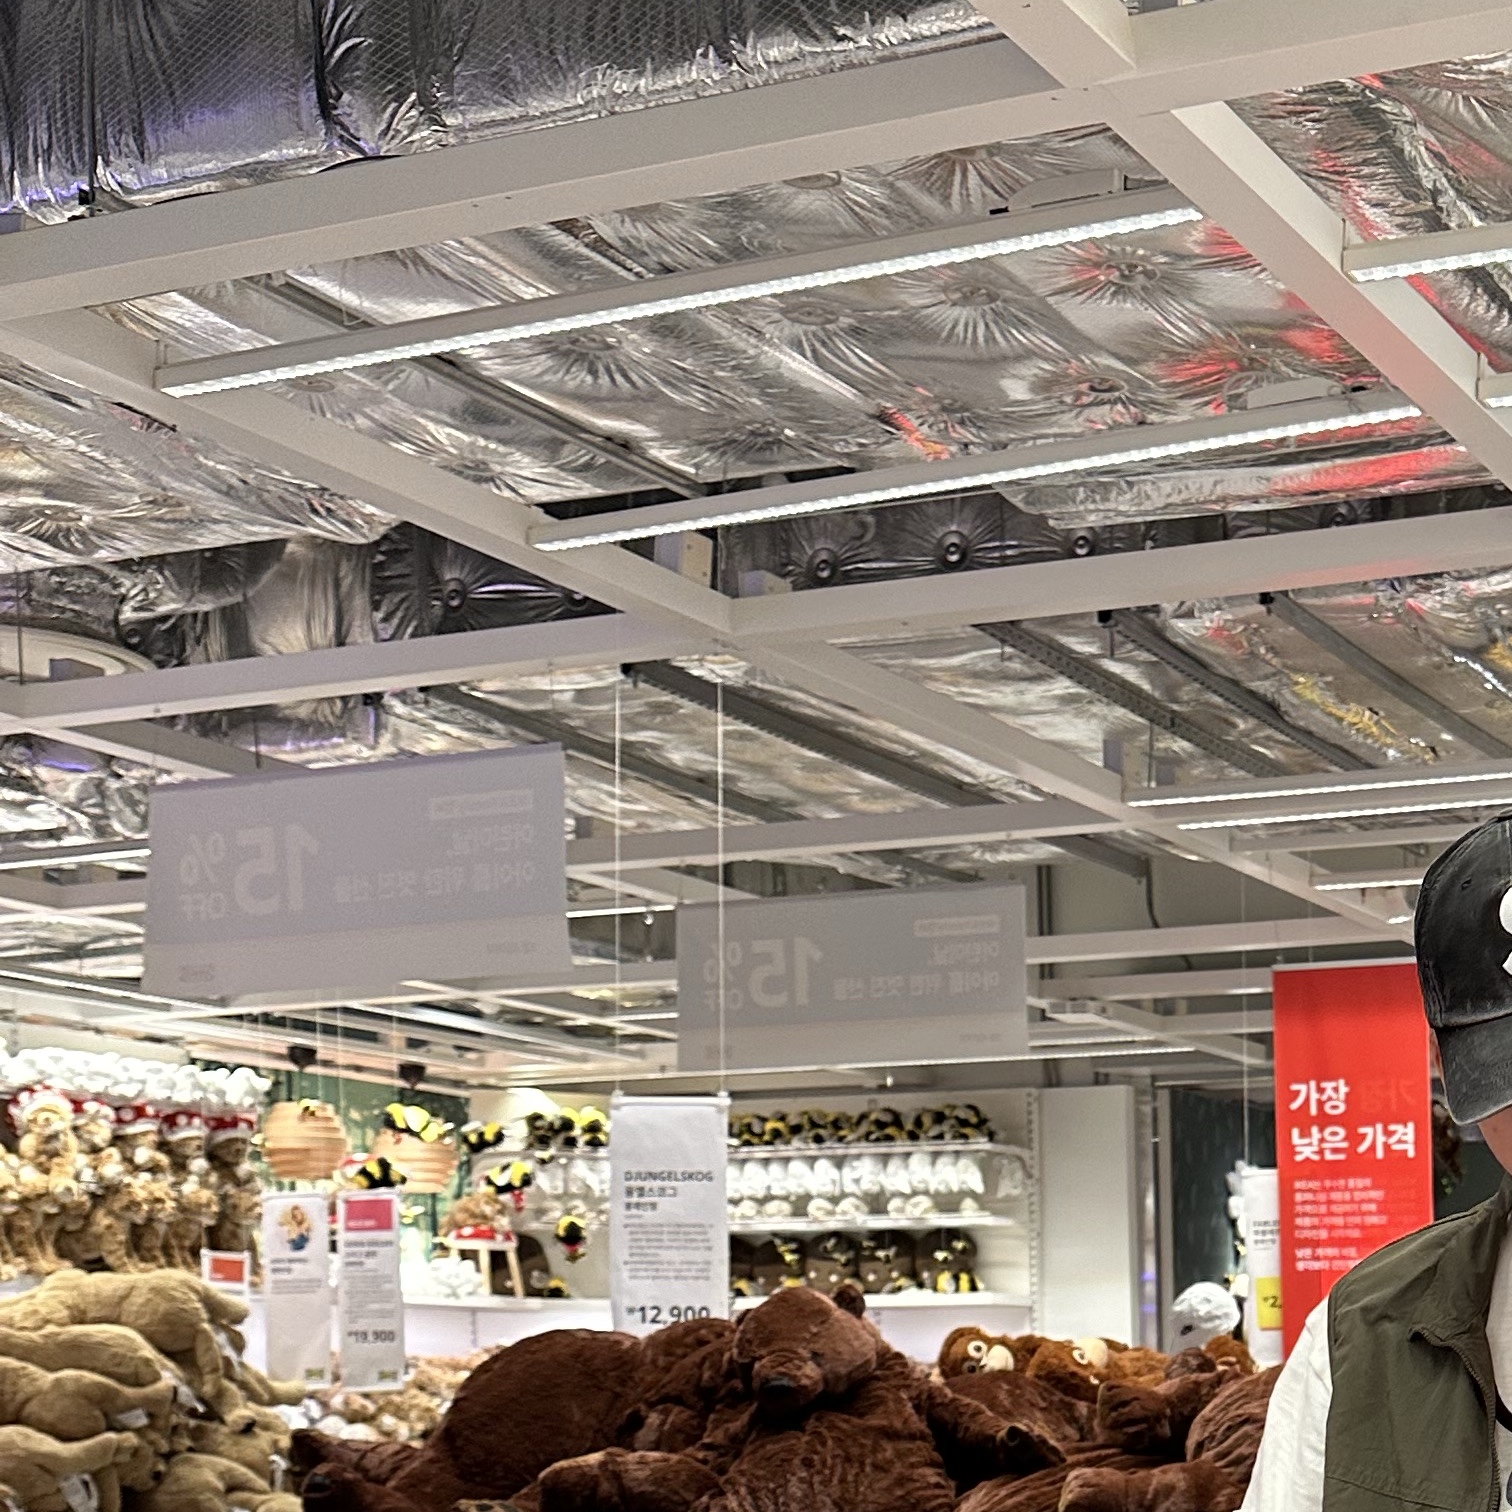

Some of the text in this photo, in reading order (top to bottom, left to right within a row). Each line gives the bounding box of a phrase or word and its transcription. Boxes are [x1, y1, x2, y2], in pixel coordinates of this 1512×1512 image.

[1289, 1079, 1349, 1116] 가장
[1291, 1121, 1416, 1162] 낮은 가격
[624, 1170, 714, 1182] DJUNGELSKOG
